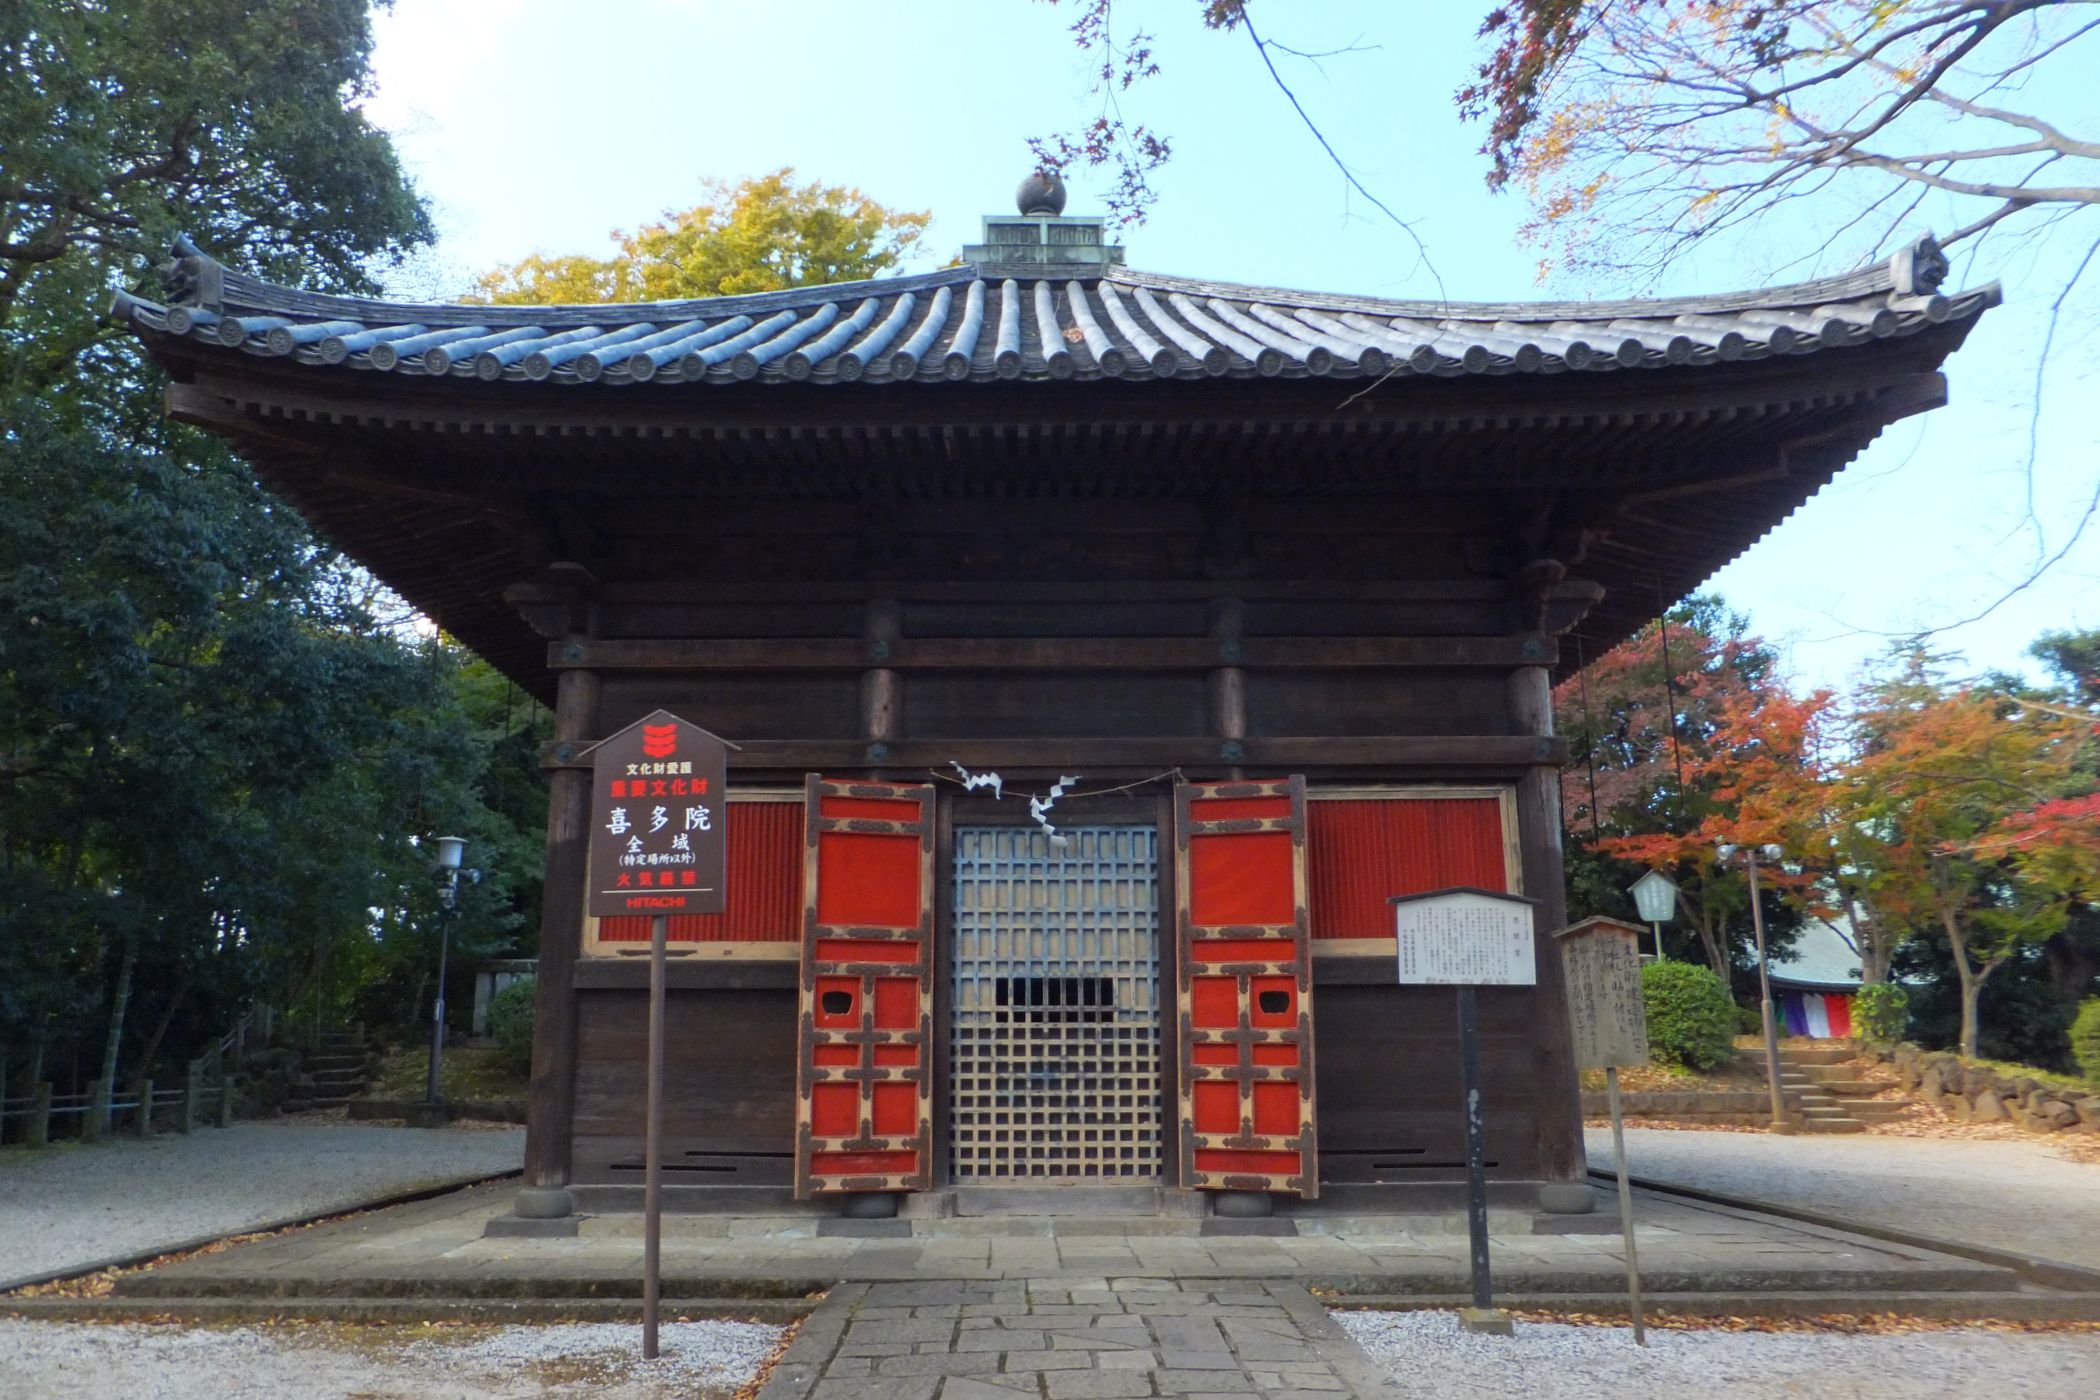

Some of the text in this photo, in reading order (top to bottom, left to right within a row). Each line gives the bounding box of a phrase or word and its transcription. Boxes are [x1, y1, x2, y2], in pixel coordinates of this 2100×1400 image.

[626, 762, 692, 776] 文化財愛護
[610, 778, 708, 797] 重要文化財
[606, 805, 711, 835] 喜多院
[626, 833, 690, 853] 全域
[619, 852, 696, 866] (特定場所以外)
[617, 871, 698, 887] 火気厳禁
[626, 897, 687, 908] HITACHI
